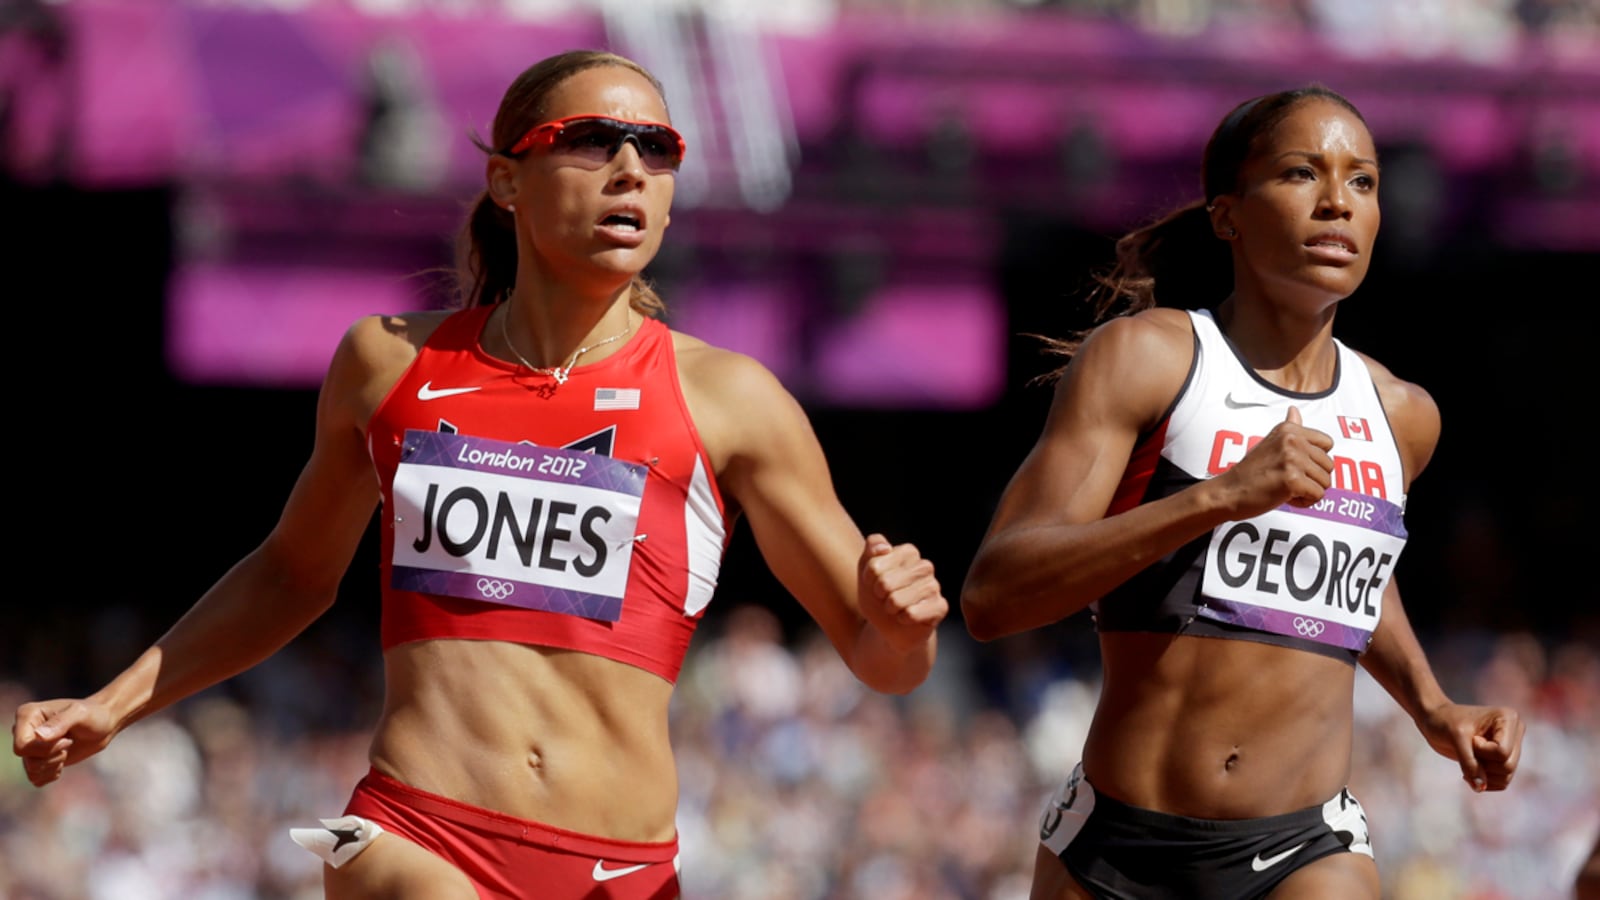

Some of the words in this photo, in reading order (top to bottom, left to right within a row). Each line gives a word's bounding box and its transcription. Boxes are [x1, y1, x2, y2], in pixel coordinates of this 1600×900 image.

[457, 443, 534, 472] London
[538, 455, 587, 479] 2012
[1207, 430, 1387, 500] CDA
[412, 483, 612, 577] JONES
[1338, 497, 1375, 522] 2012
[1217, 522, 1393, 617] GEORGE
